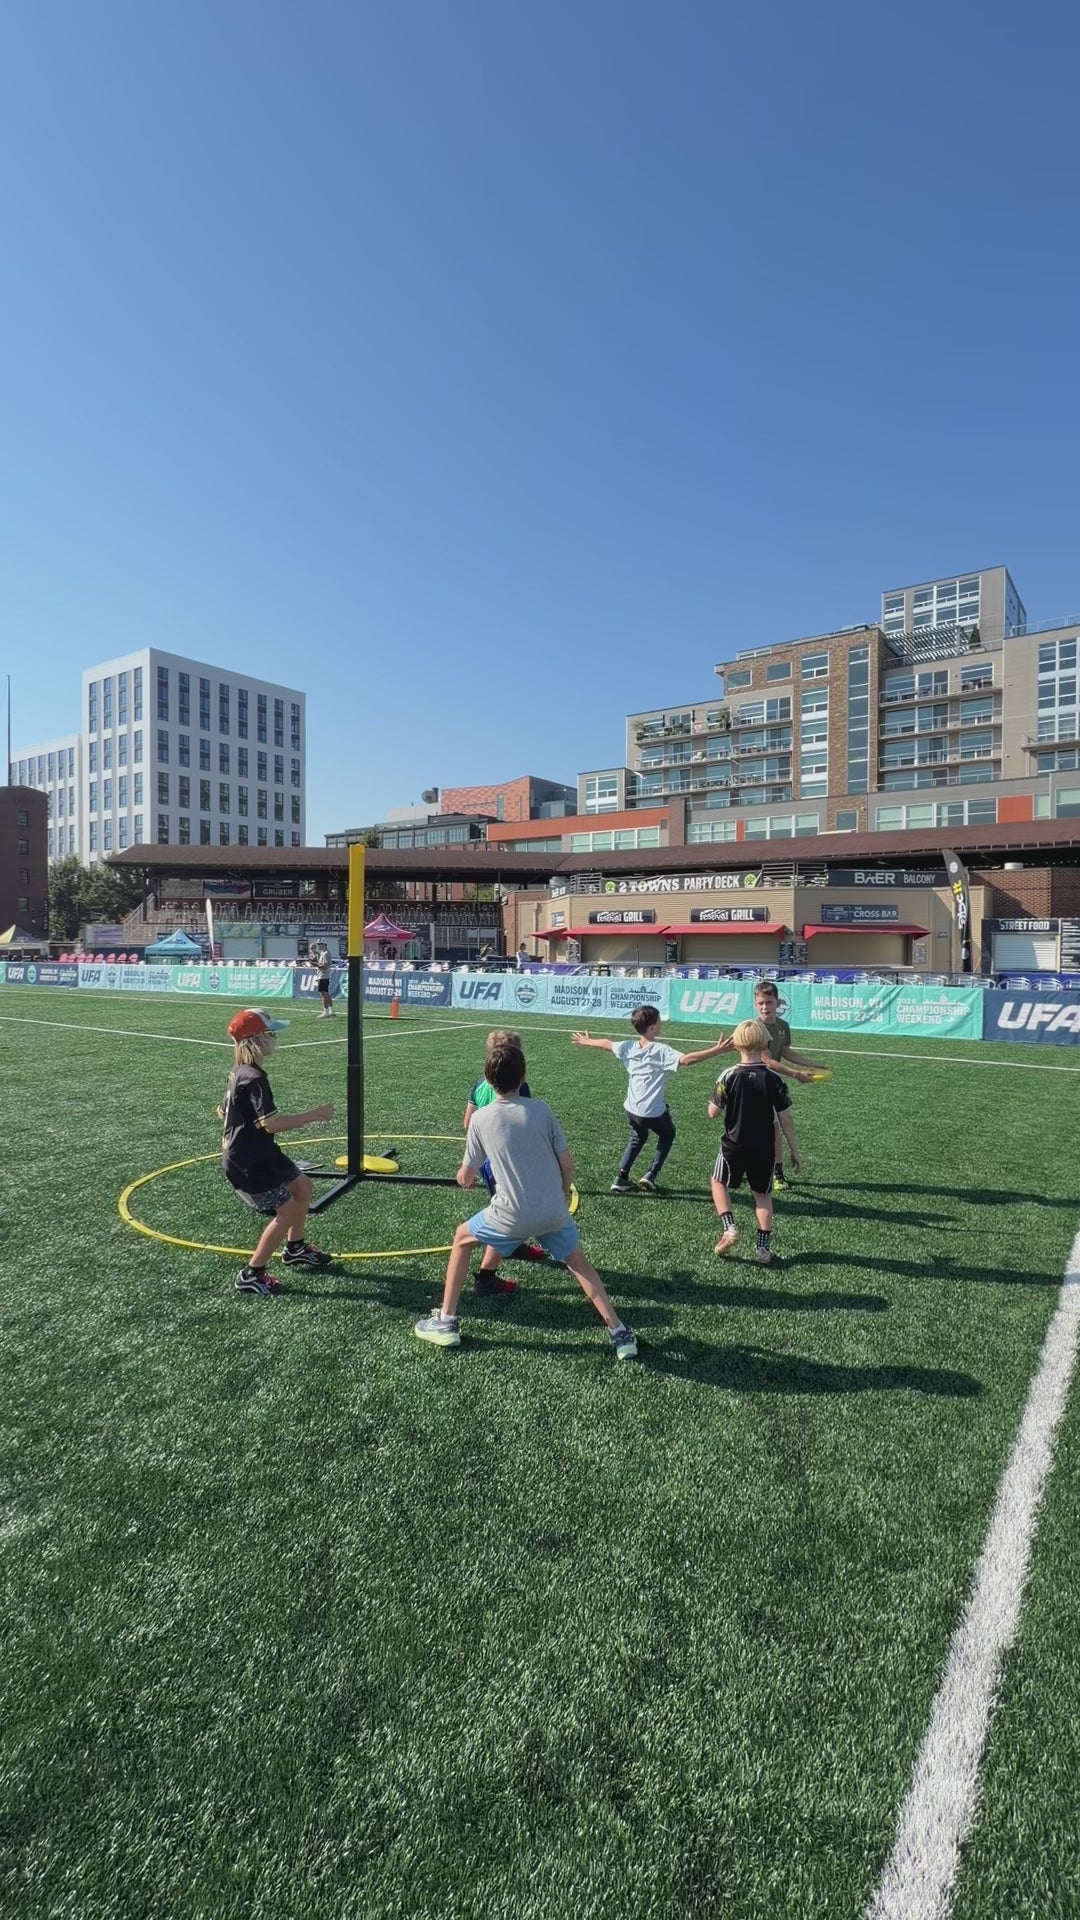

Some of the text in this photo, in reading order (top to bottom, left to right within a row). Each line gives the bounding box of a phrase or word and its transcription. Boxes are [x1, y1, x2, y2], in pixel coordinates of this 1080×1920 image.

[619, 875, 740, 893] 2 TOWNS PARTY DECK
[854, 872, 936, 884] BAER BALCONY
[623, 911, 644, 923] GRILL
[730, 908, 755, 921] GRILL
[853, 910, 880, 918] CROSS
[881, 910, 898, 918] BAR
[1000, 921, 1050, 931] STREET FOOD
[8, 967, 25, 980] UFA
[81, 969, 102, 983] UFA
[177, 972, 200, 987] UFA
[300, 974, 320, 991] UF
[365, 986, 387, 995] AUGUST
[459, 980, 503, 1000] UFA
[554, 985, 602, 996] MADISON, WI
[551, 996, 602, 1007] AUGUST 27-28
[610, 992, 662, 1002] CHAMPIONSHIP
[680, 989, 740, 1015] UFA
[815, 996, 883, 1010] MADISON, WI
[810, 1009, 884, 1023] AUGUST 27-28
[896, 1004, 970, 1016] CHAMPIONSHIP
[896, 1014, 942, 1024] WEEKEND
[997, 1002, 1080, 1032] UFA
